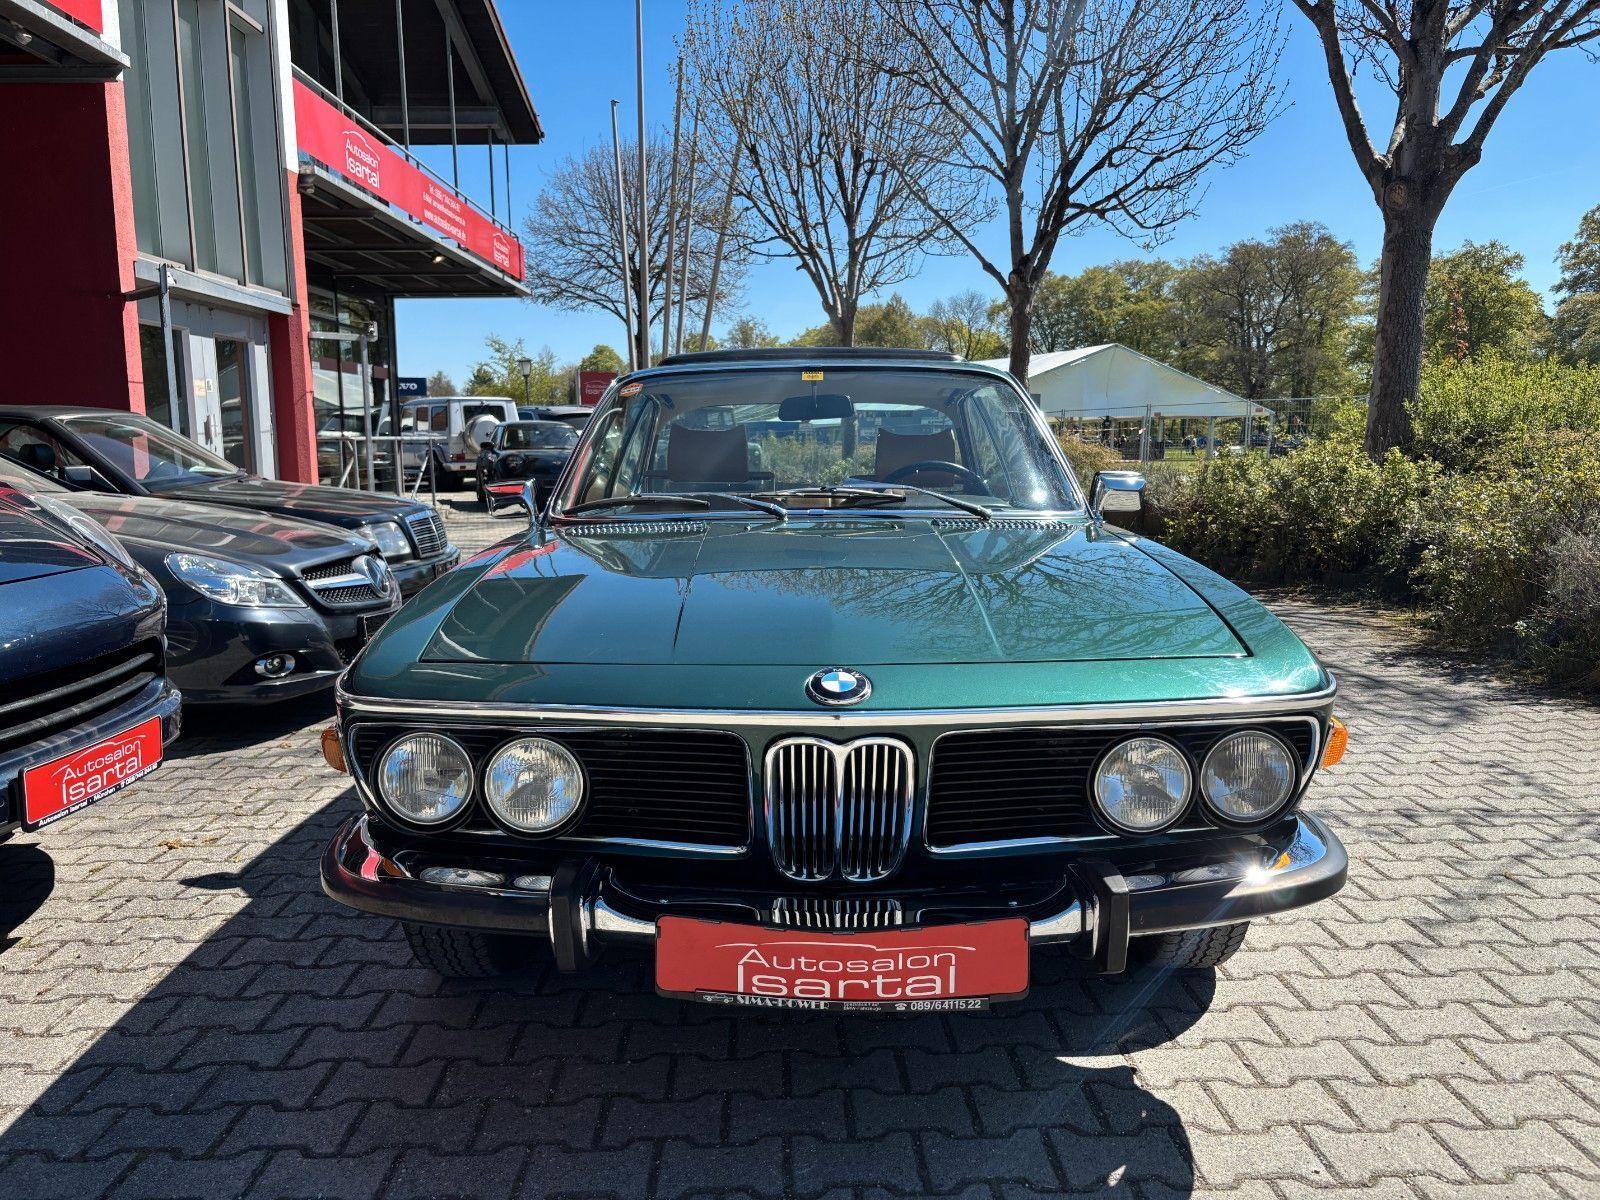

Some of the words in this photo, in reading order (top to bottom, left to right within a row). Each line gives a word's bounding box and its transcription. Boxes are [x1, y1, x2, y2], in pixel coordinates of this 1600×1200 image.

[346, 137, 379, 169] Autosalon
[346, 149, 380, 188] Isartal
[62, 740, 141, 783] Autosalon
[62, 749, 142, 804] Isartal
[737, 948, 956, 972] Autosalon
[737, 964, 956, 999] Isartal
